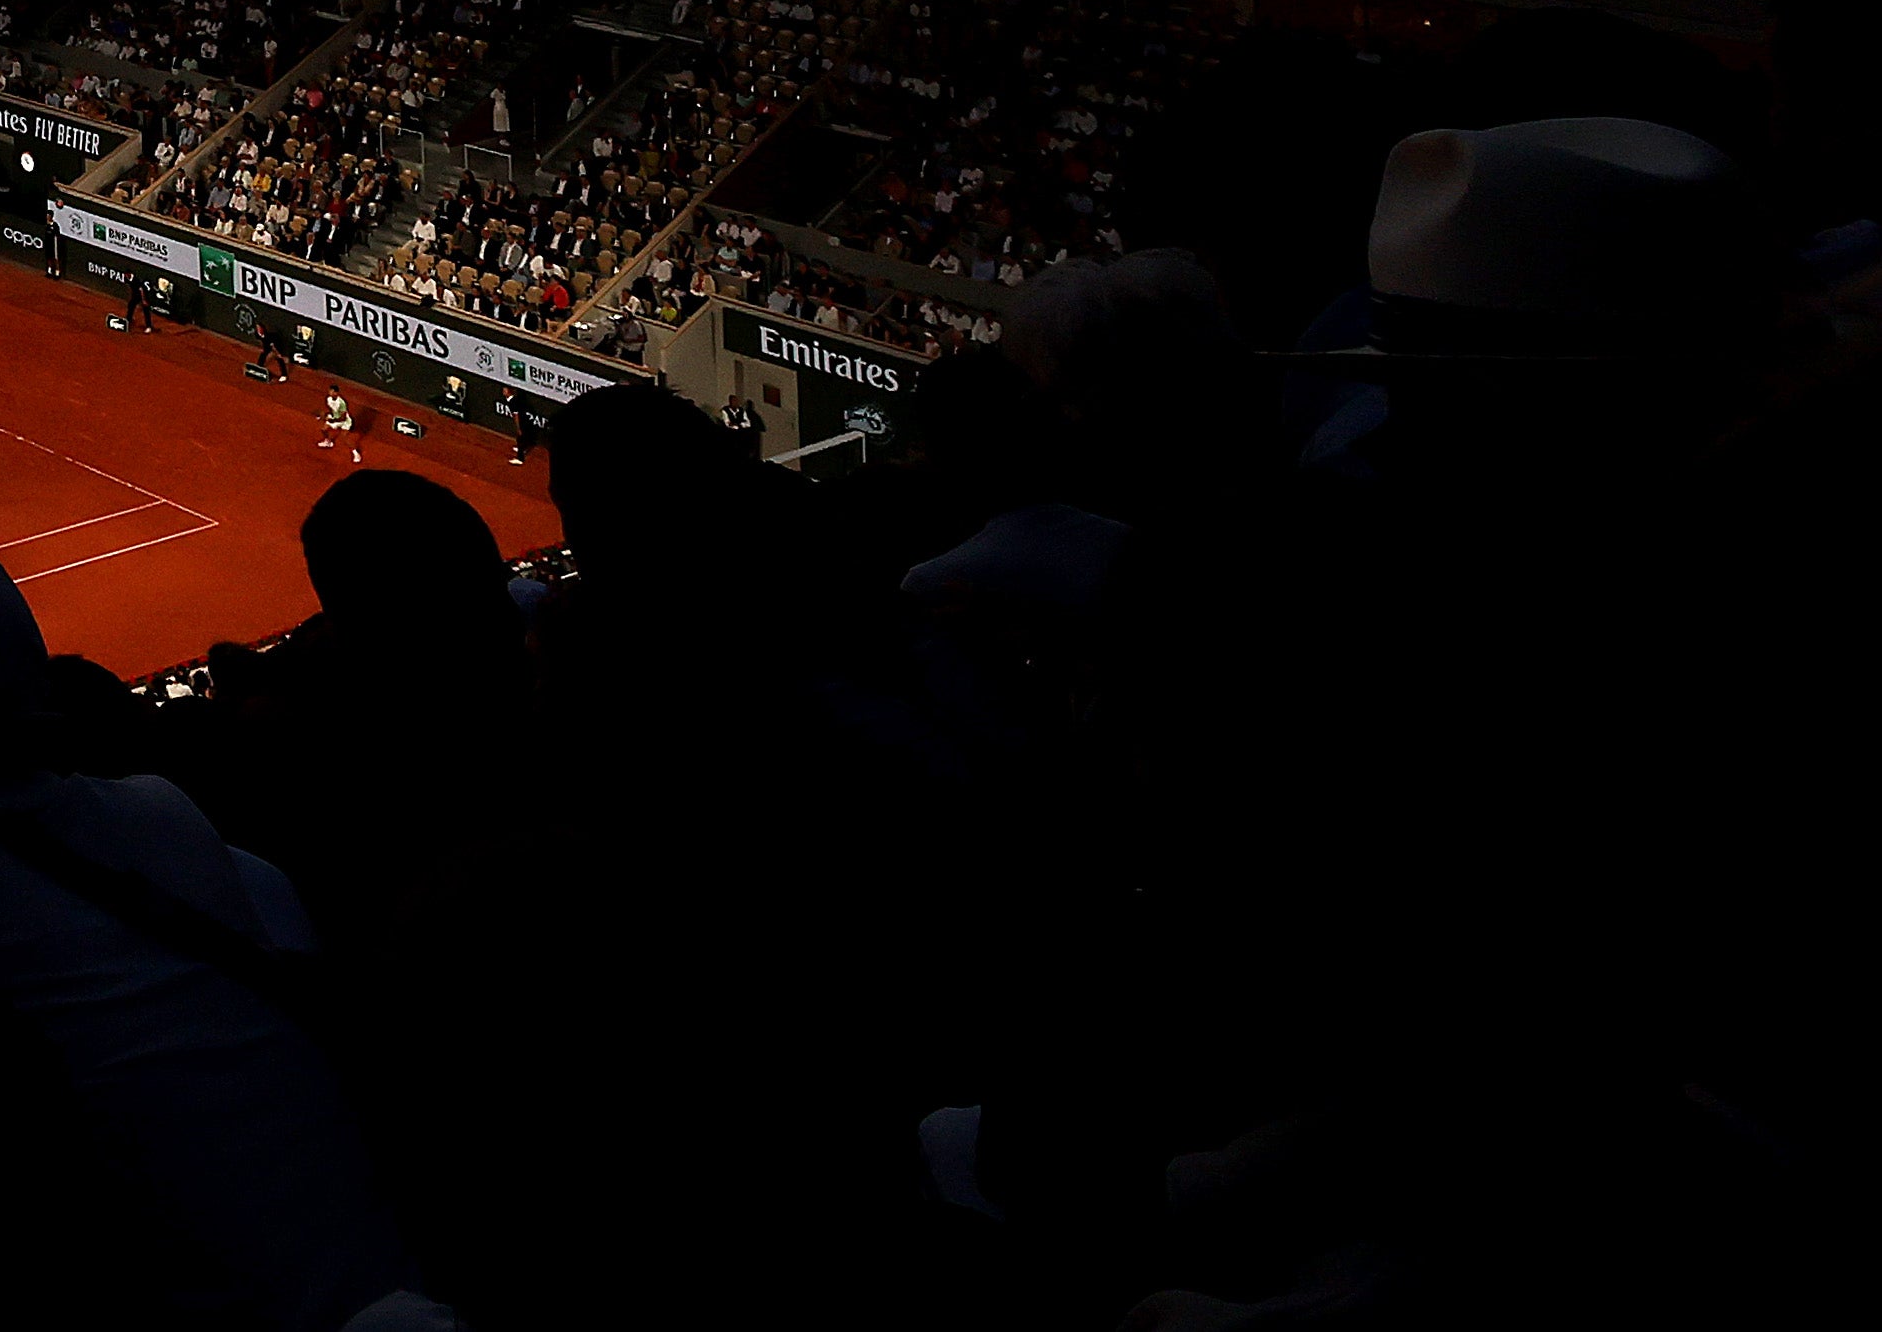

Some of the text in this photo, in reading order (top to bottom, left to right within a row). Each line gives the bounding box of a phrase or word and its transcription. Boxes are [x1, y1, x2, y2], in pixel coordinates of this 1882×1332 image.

[34, 115, 56, 141] FLY
[56, 123, 100, 157] BETTER
[3, 226, 44, 249] oppo
[108, 227, 128, 242] BNP
[128, 234, 168, 256] PARIBAS
[241, 266, 449, 358] BNP PARIBAS
[529, 364, 555, 383] BNP
[757, 324, 900, 394] Emirates
